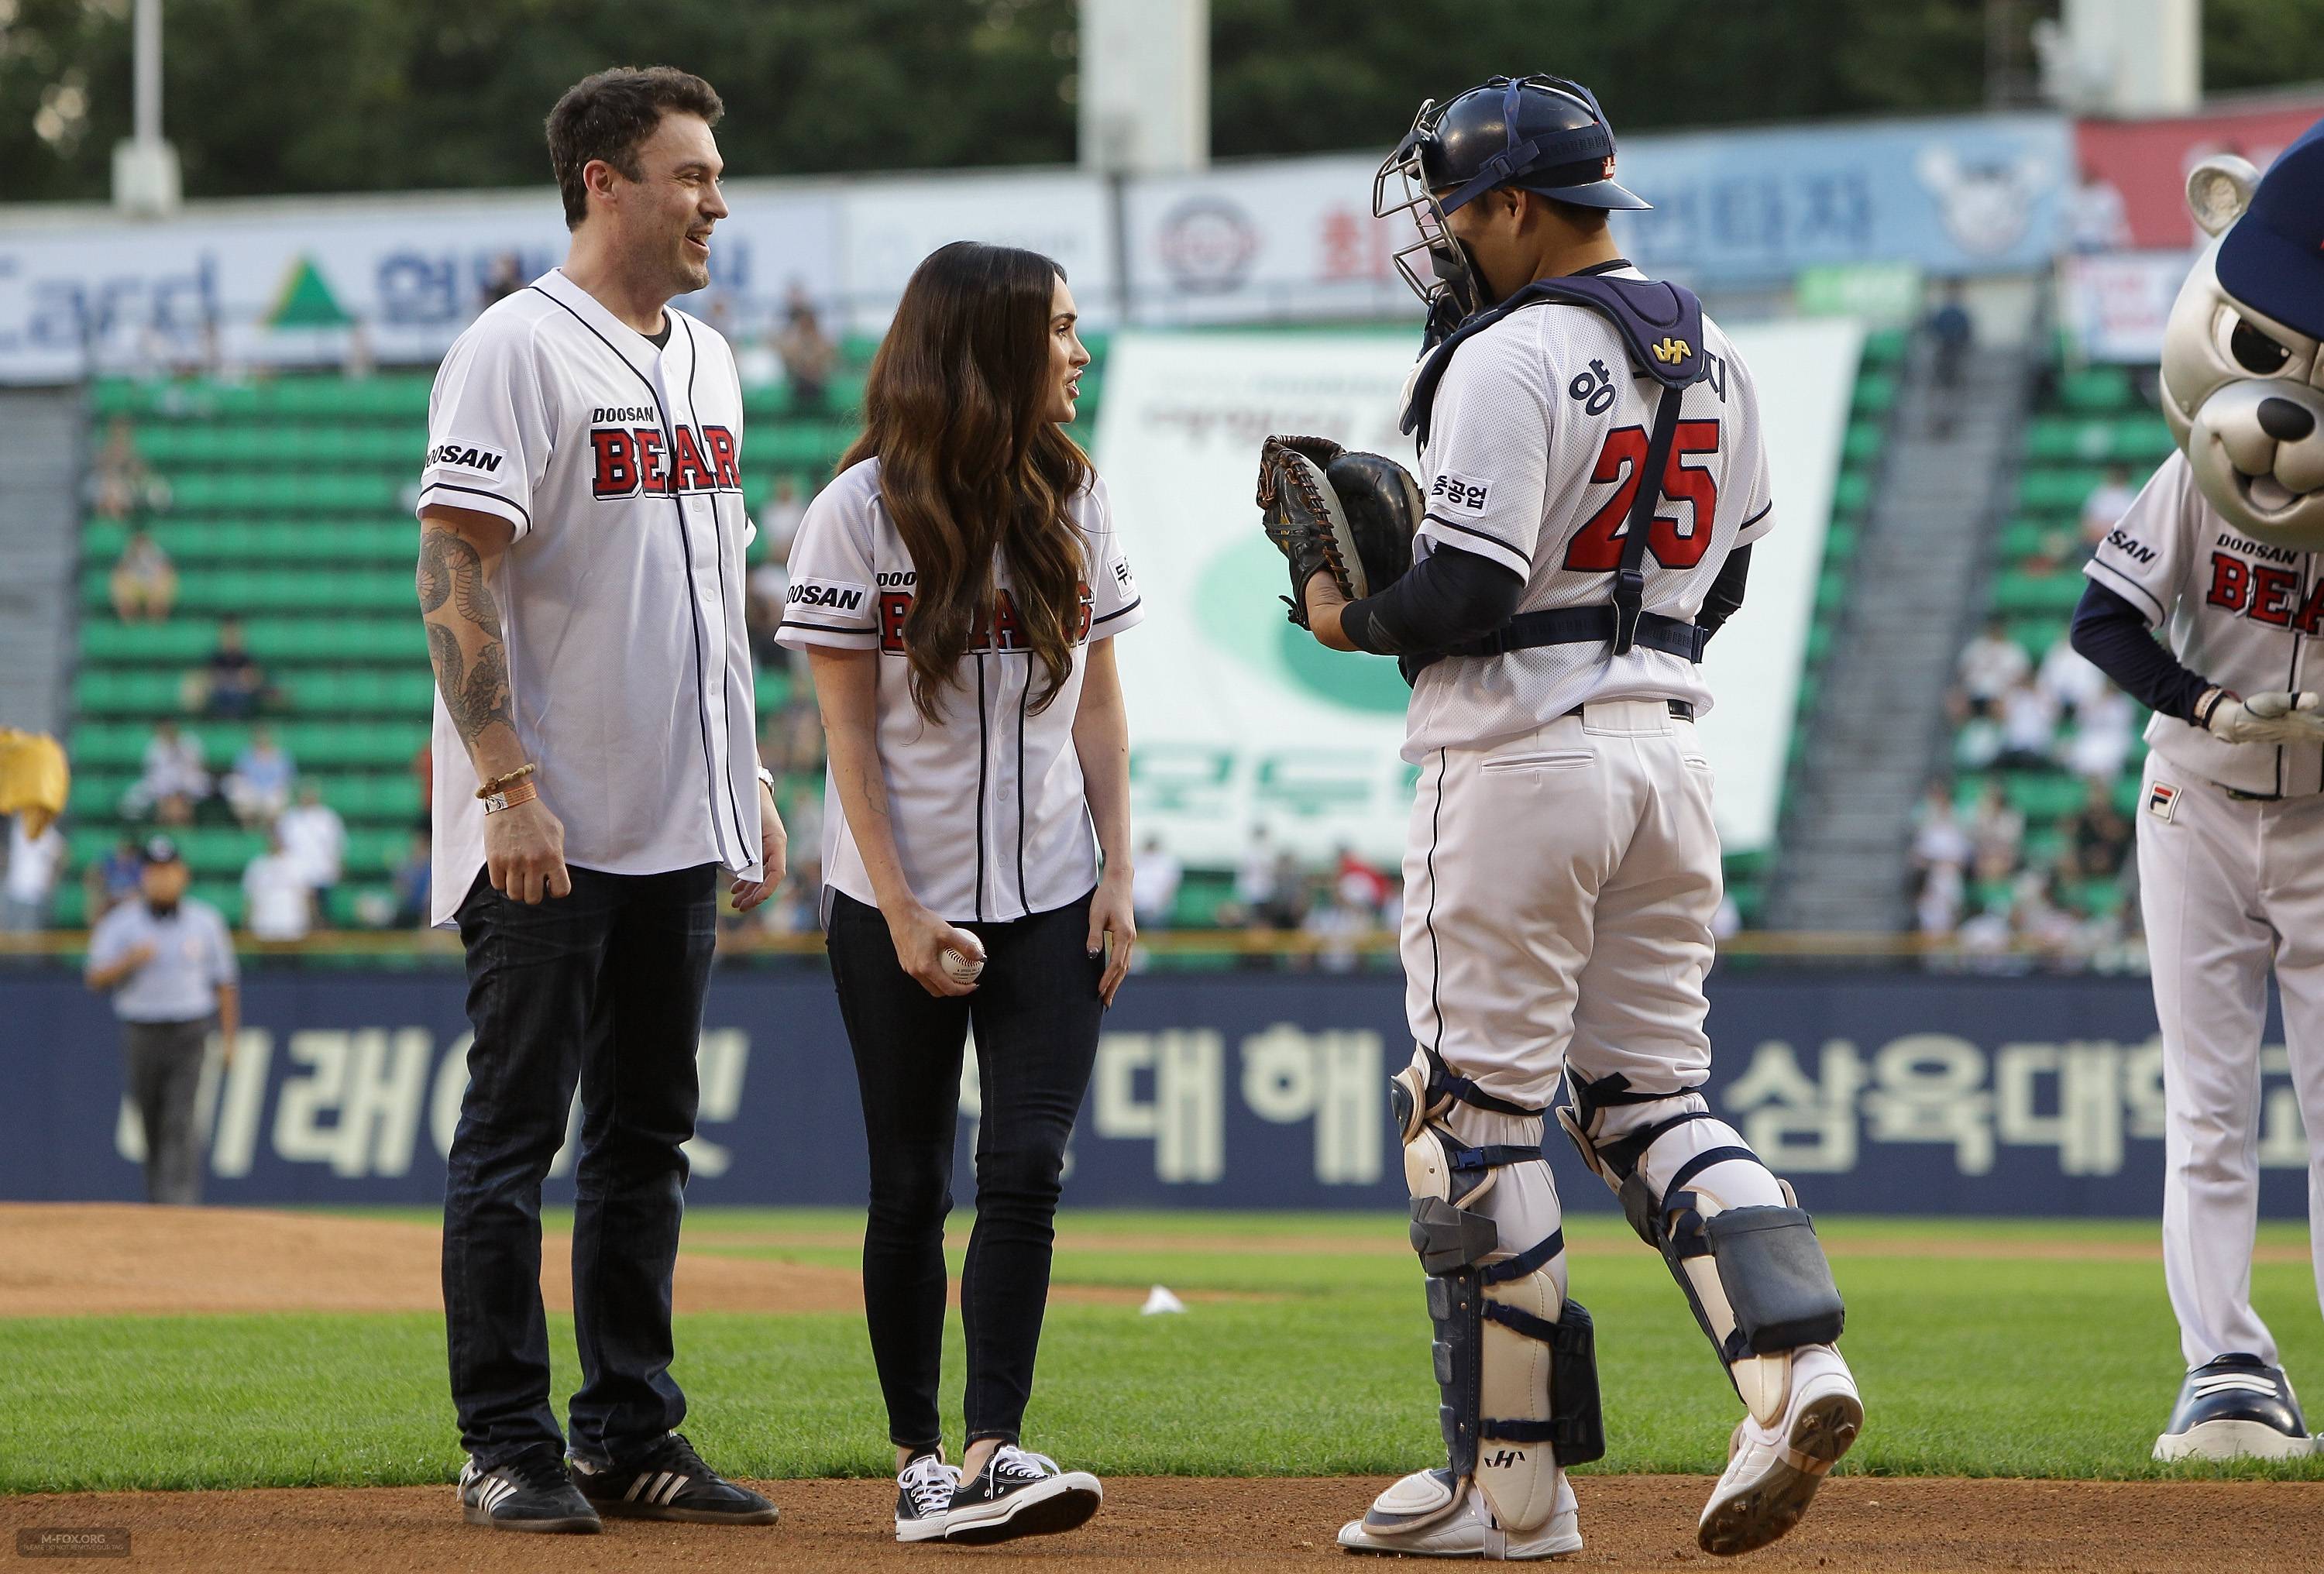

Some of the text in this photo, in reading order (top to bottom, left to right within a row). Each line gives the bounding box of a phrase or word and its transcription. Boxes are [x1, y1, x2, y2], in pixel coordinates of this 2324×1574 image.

[1569, 357, 1726, 416] 양지
[592, 406, 654, 424] DOOSAN
[1562, 418, 1721, 573] 25
[2107, 530, 2157, 564] SAN
[2217, 533, 2299, 566] DOOSAN
[876, 572, 916, 587] DOO
[786, 584, 863, 610] OOSAN
